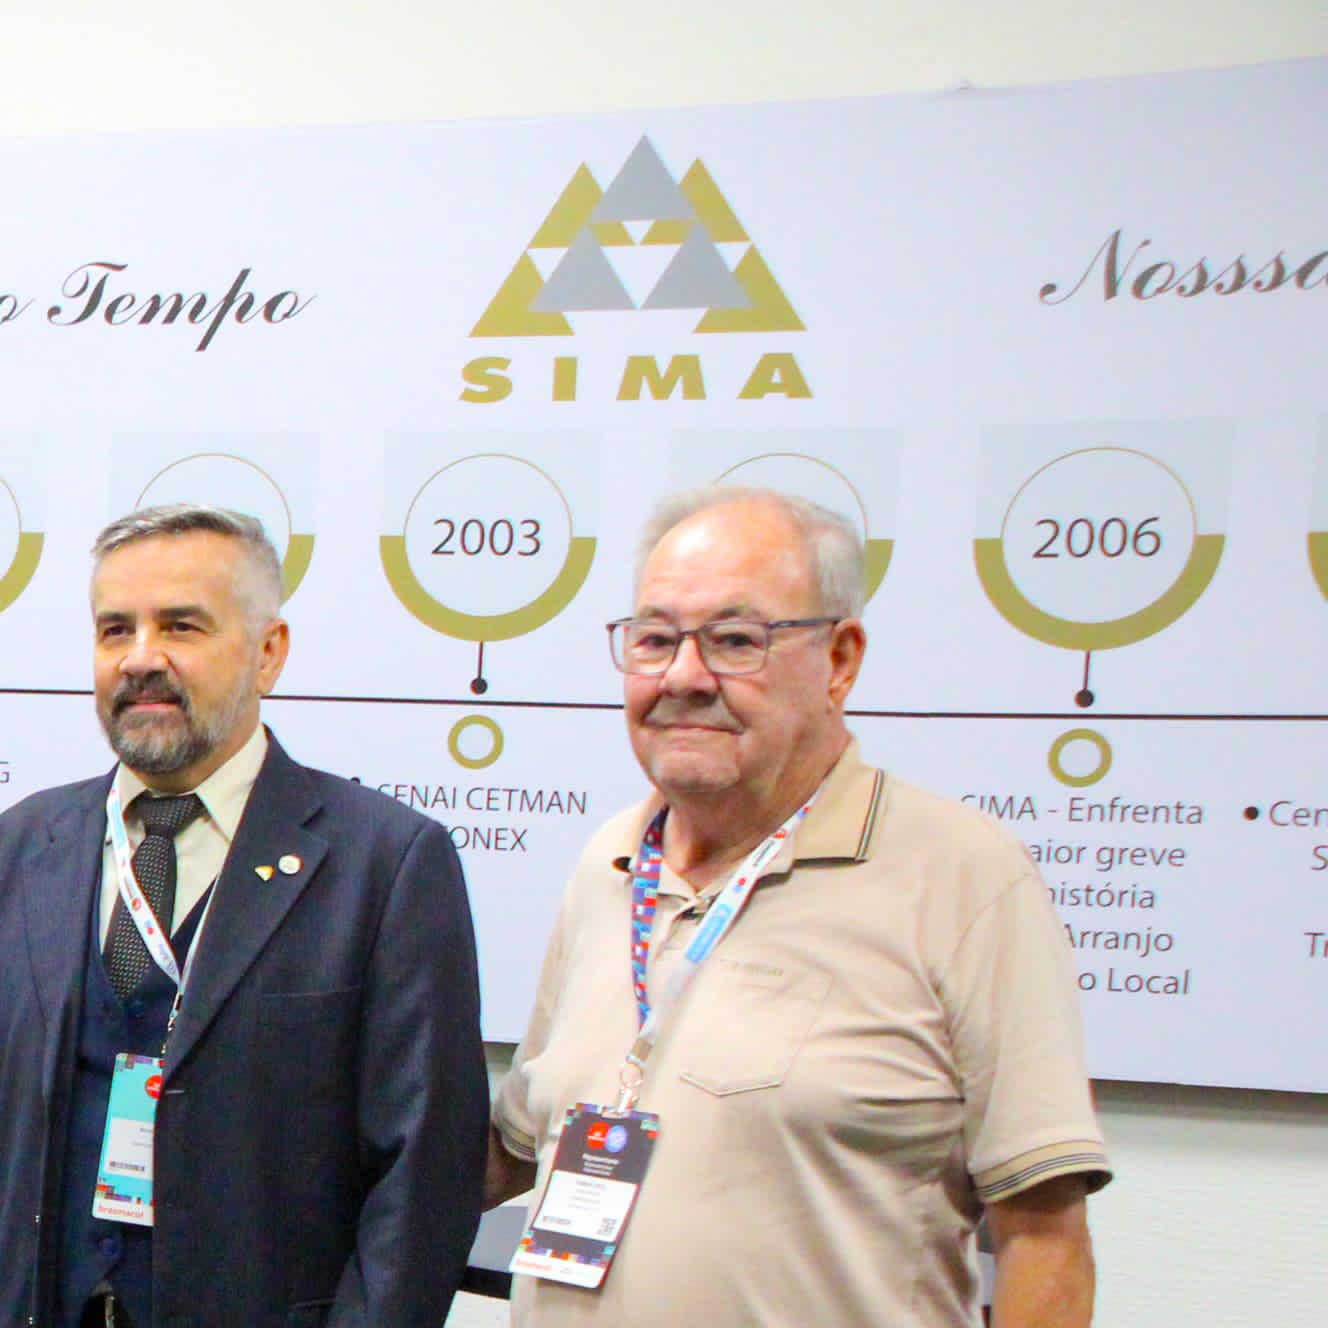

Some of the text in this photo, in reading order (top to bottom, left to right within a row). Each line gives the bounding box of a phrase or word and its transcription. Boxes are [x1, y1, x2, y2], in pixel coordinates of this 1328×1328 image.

[47, 261, 316, 353] Tempo
[459, 351, 814, 404] SIMA
[431, 518, 542, 556] 2003
[1032, 516, 1163, 559] 2006
[466, 786, 588, 815] CETMAN
[1068, 795, 1204, 825] Enfrenta
[1096, 845, 1187, 873] greve
[1107, 967, 1191, 995] Local
